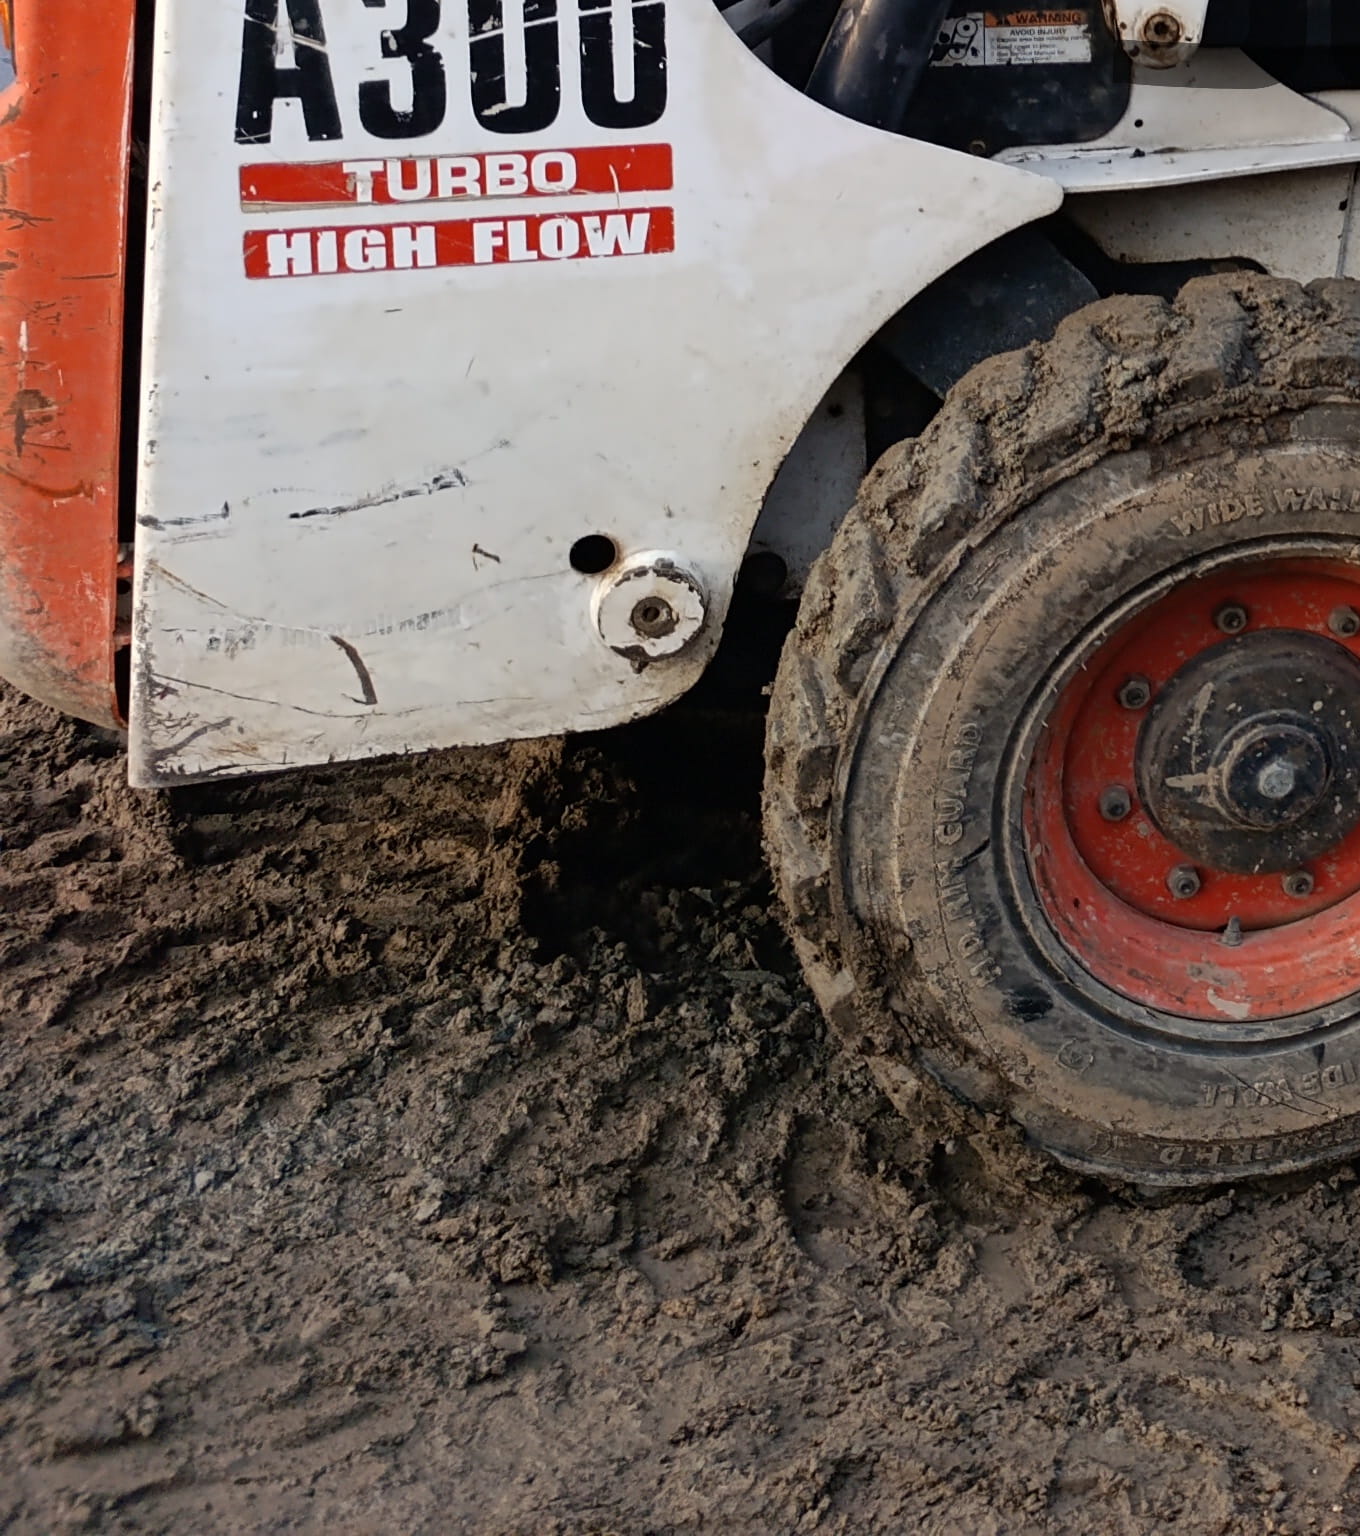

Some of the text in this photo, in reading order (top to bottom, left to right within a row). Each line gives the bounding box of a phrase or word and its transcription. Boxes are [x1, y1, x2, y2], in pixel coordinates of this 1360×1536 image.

[1016, 13, 1081, 24] WARNING
[342, 151, 577, 203] TURBO
[266, 213, 651, 277] HIGH FLOW
[1170, 493, 1265, 537] WIDE
[936, 722, 982, 845] GUARD
